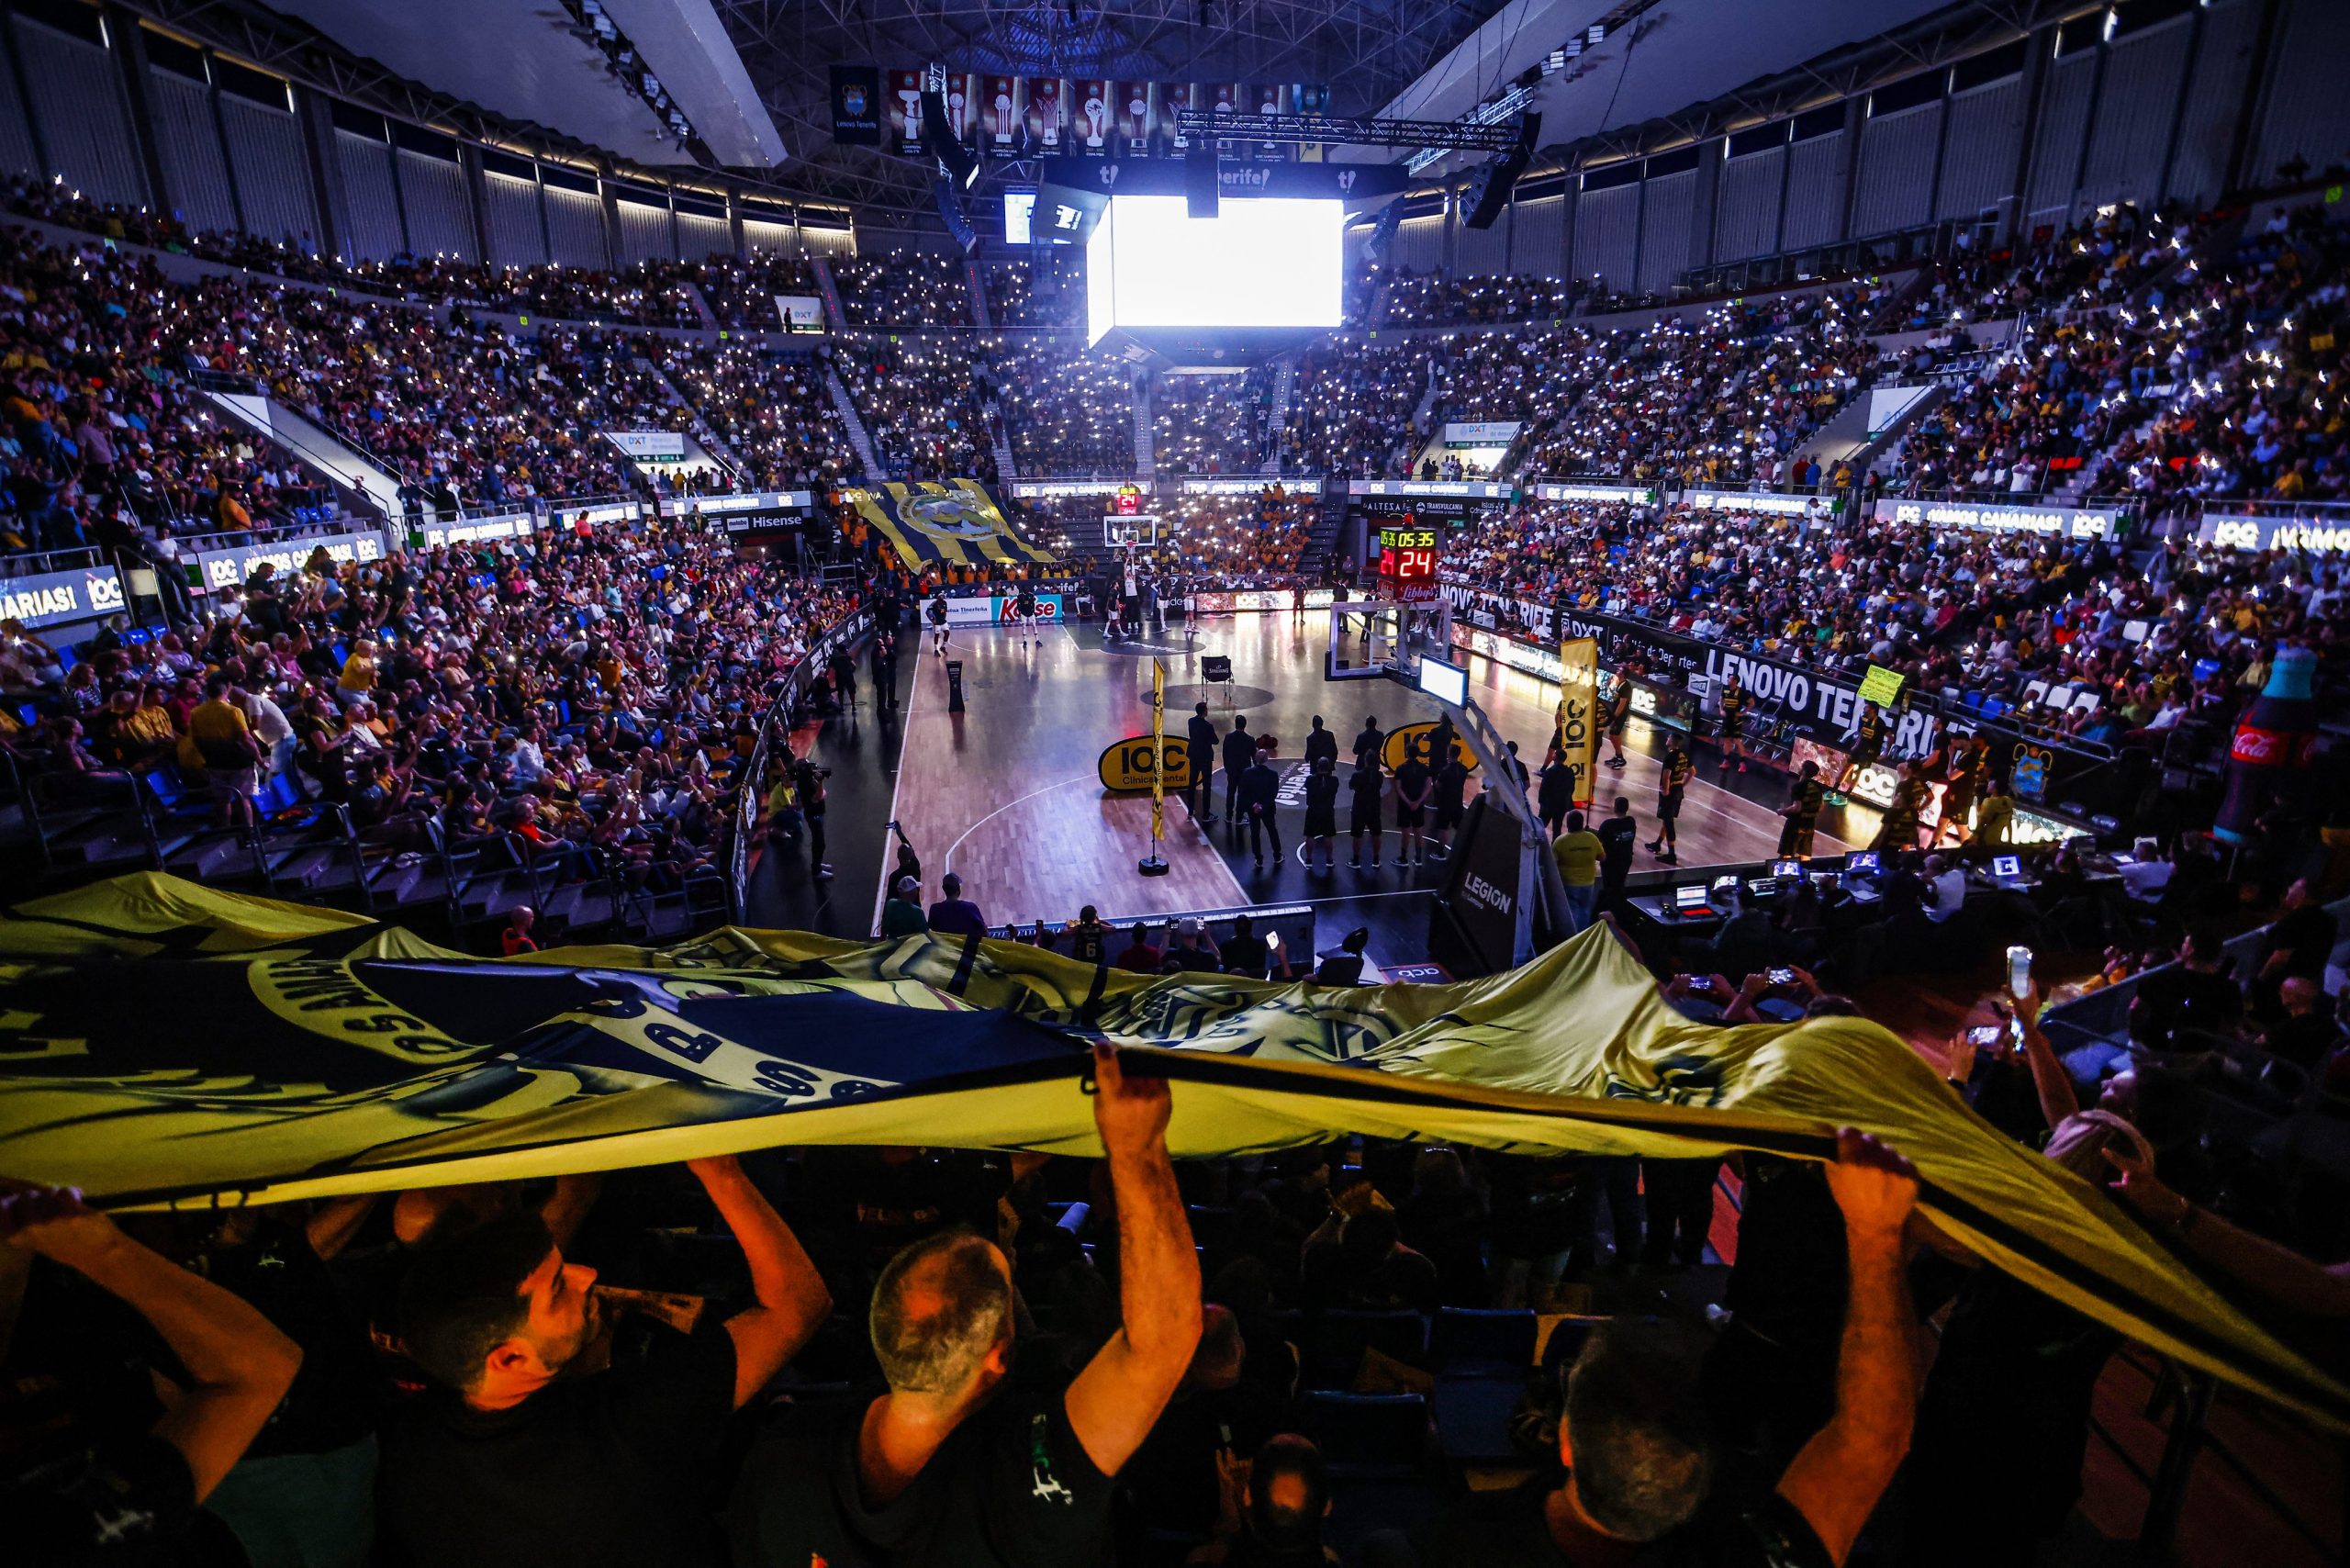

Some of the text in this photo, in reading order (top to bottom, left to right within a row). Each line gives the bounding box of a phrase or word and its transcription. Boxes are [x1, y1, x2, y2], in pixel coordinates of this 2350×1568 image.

[1469, 425, 1486, 433] DXT
[628, 436, 646, 445] DXT
[1121, 496, 1136, 505] 24
[753, 516, 802, 528] Hisense
[1897, 506, 1921, 520] IOC
[1980, 511, 2064, 532] CANARIAS!
[2072, 514, 2108, 531] IOC
[208, 558, 238, 581] IOC
[356, 539, 377, 560] IOC
[1400, 551, 1430, 577] 24
[86, 577, 124, 604] IOC
[1398, 583, 1435, 602] Libby's
[1572, 620, 1604, 641] DXT
[1706, 649, 1810, 711] LENOVO
[1631, 689, 1656, 710] IOC
[1162, 773, 1187, 783] ental
[1847, 767, 1896, 798] OC
[1464, 872, 1512, 914] LEGION
[1086, 941, 1097, 958] 6
[1397, 968, 1440, 979] acb
